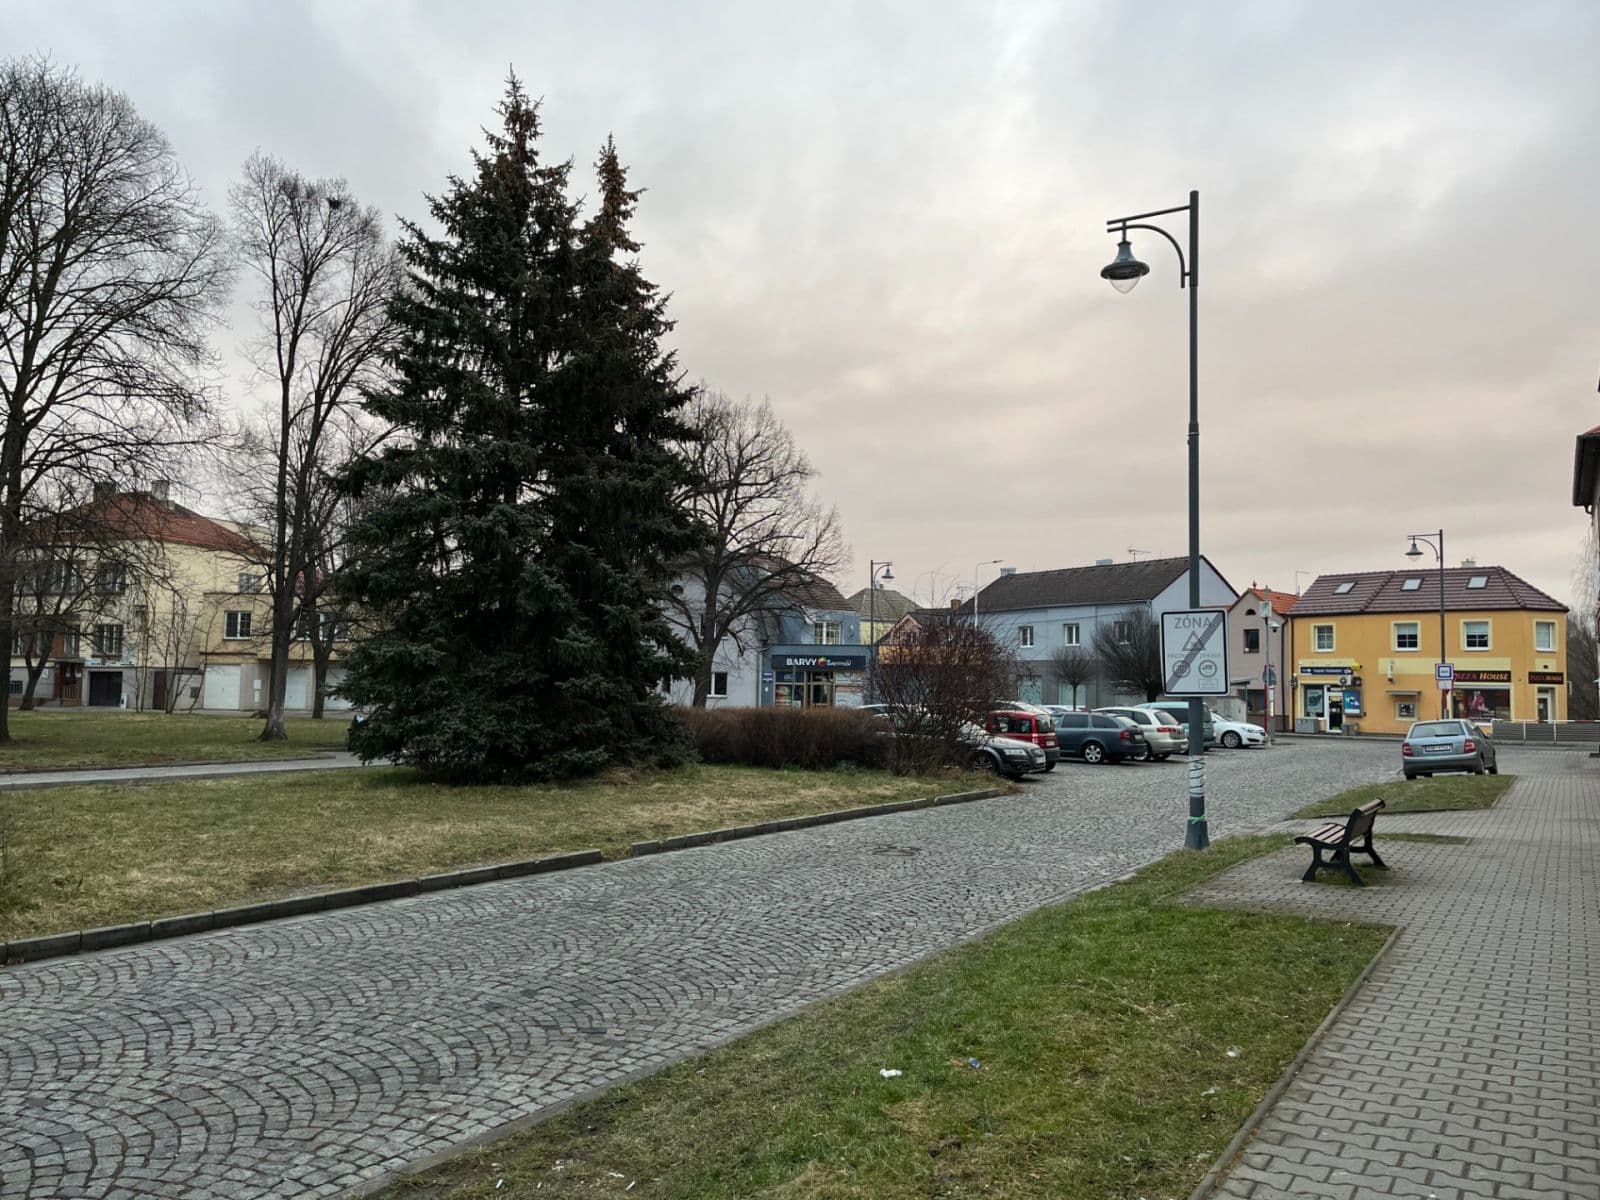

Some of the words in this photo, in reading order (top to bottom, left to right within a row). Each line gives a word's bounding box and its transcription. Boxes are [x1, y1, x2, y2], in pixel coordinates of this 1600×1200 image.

[1174, 614, 1212, 629] ZÓNA
[786, 658, 817, 666] BARVY
[1480, 672, 1508, 680] HOUSE
